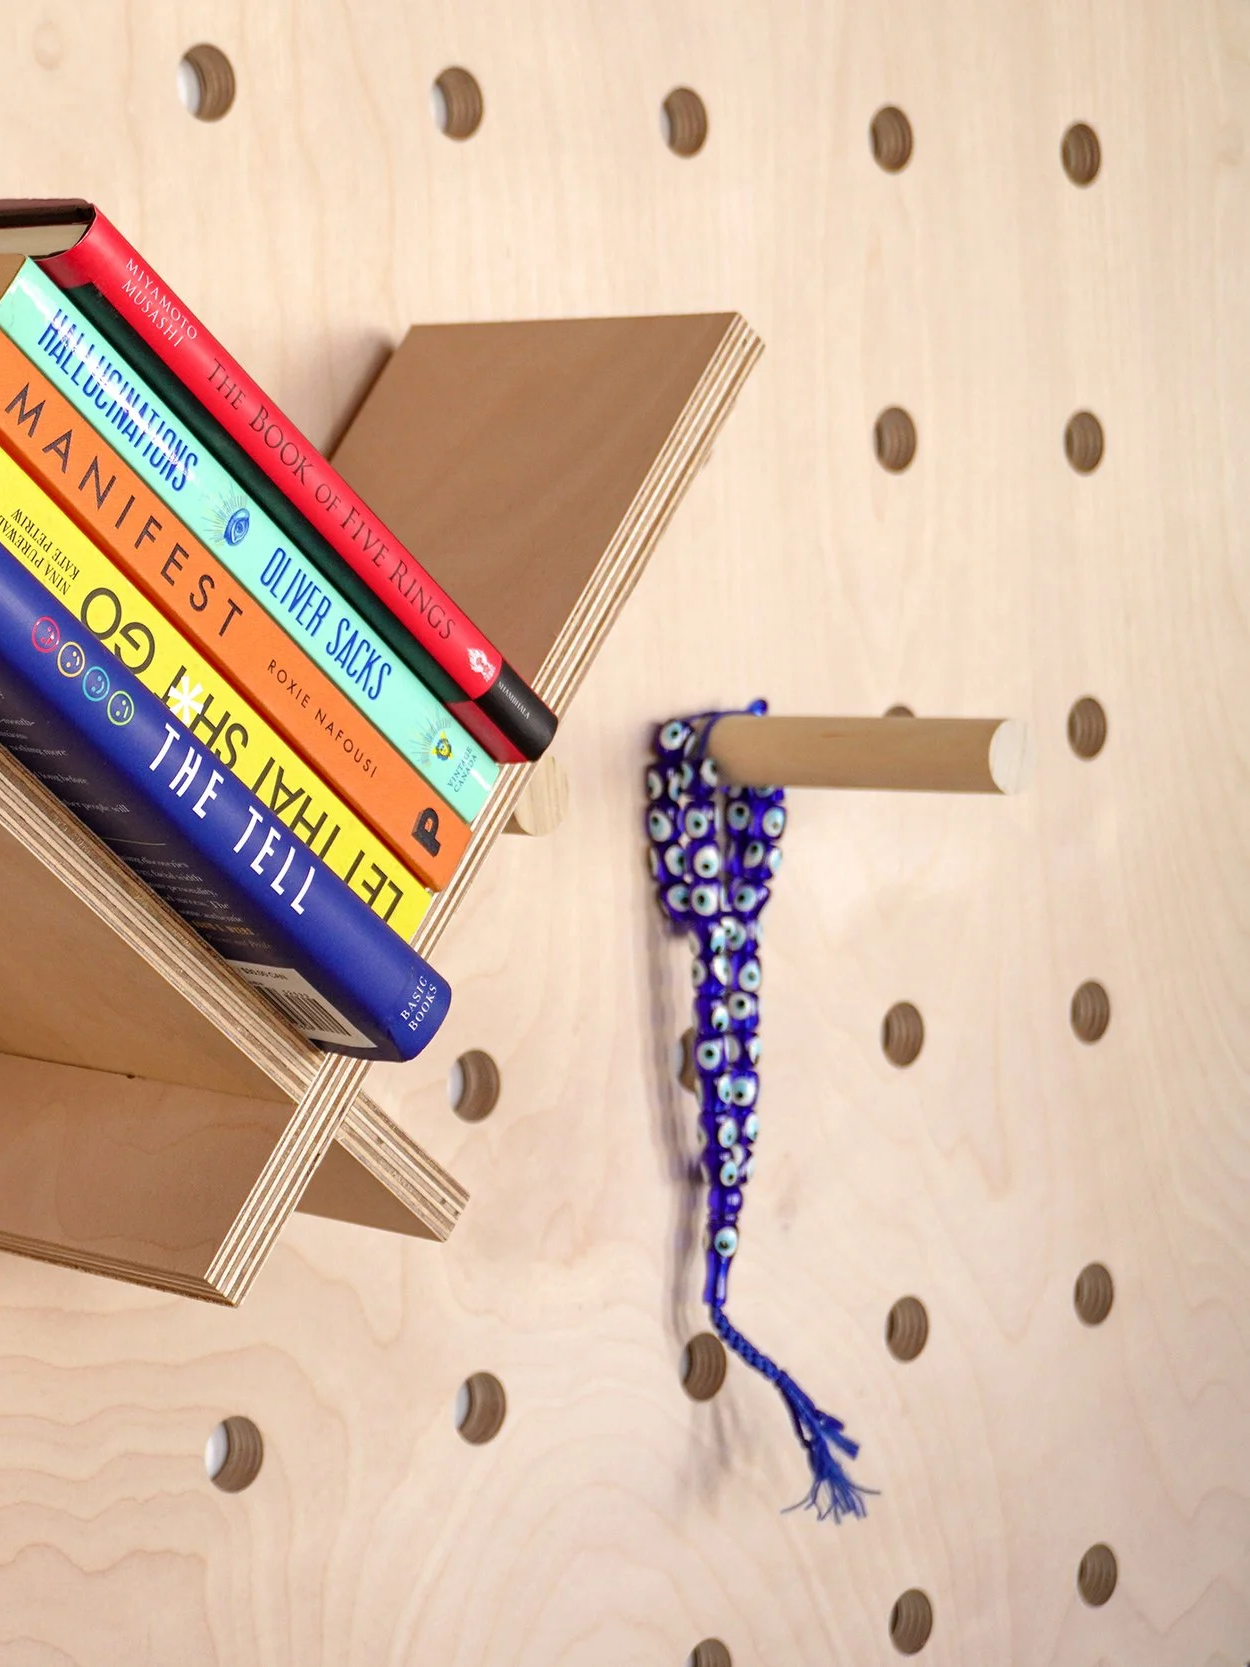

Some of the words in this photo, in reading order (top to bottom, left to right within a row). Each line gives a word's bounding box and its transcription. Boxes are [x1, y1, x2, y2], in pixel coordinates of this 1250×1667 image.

[121, 279, 184, 347] MUSASHI
[125, 258, 197, 340] MIYAMOTO
[37, 308, 198, 491] HALLUCINATIONS
[4, 382, 243, 637] MANIFEST
[10, 508, 53, 552] PETRIW
[207, 358, 246, 411] THE
[249, 405, 313, 485] BOOK
[315, 483, 341, 512] OF
[340, 506, 389, 567] FIVE
[388, 560, 456, 640] RINGS
[45, 563, 71, 595] NINA
[52, 548, 81, 581] KATE
[81, 587, 155, 675] GO
[260, 547, 332, 637] OLIVER
[326, 617, 392, 700] SACKS
[267, 659, 311, 709] ROXIE
[314, 708, 378, 778] NAFOUSI
[447, 745, 473, 787] VINTAGE
[453, 754, 478, 793] CANADA
[149, 722, 225, 819] THE
[232, 805, 316, 915] TELL
[400, 975, 429, 1021] BASIC
[408, 983, 438, 1032] BOOKS
